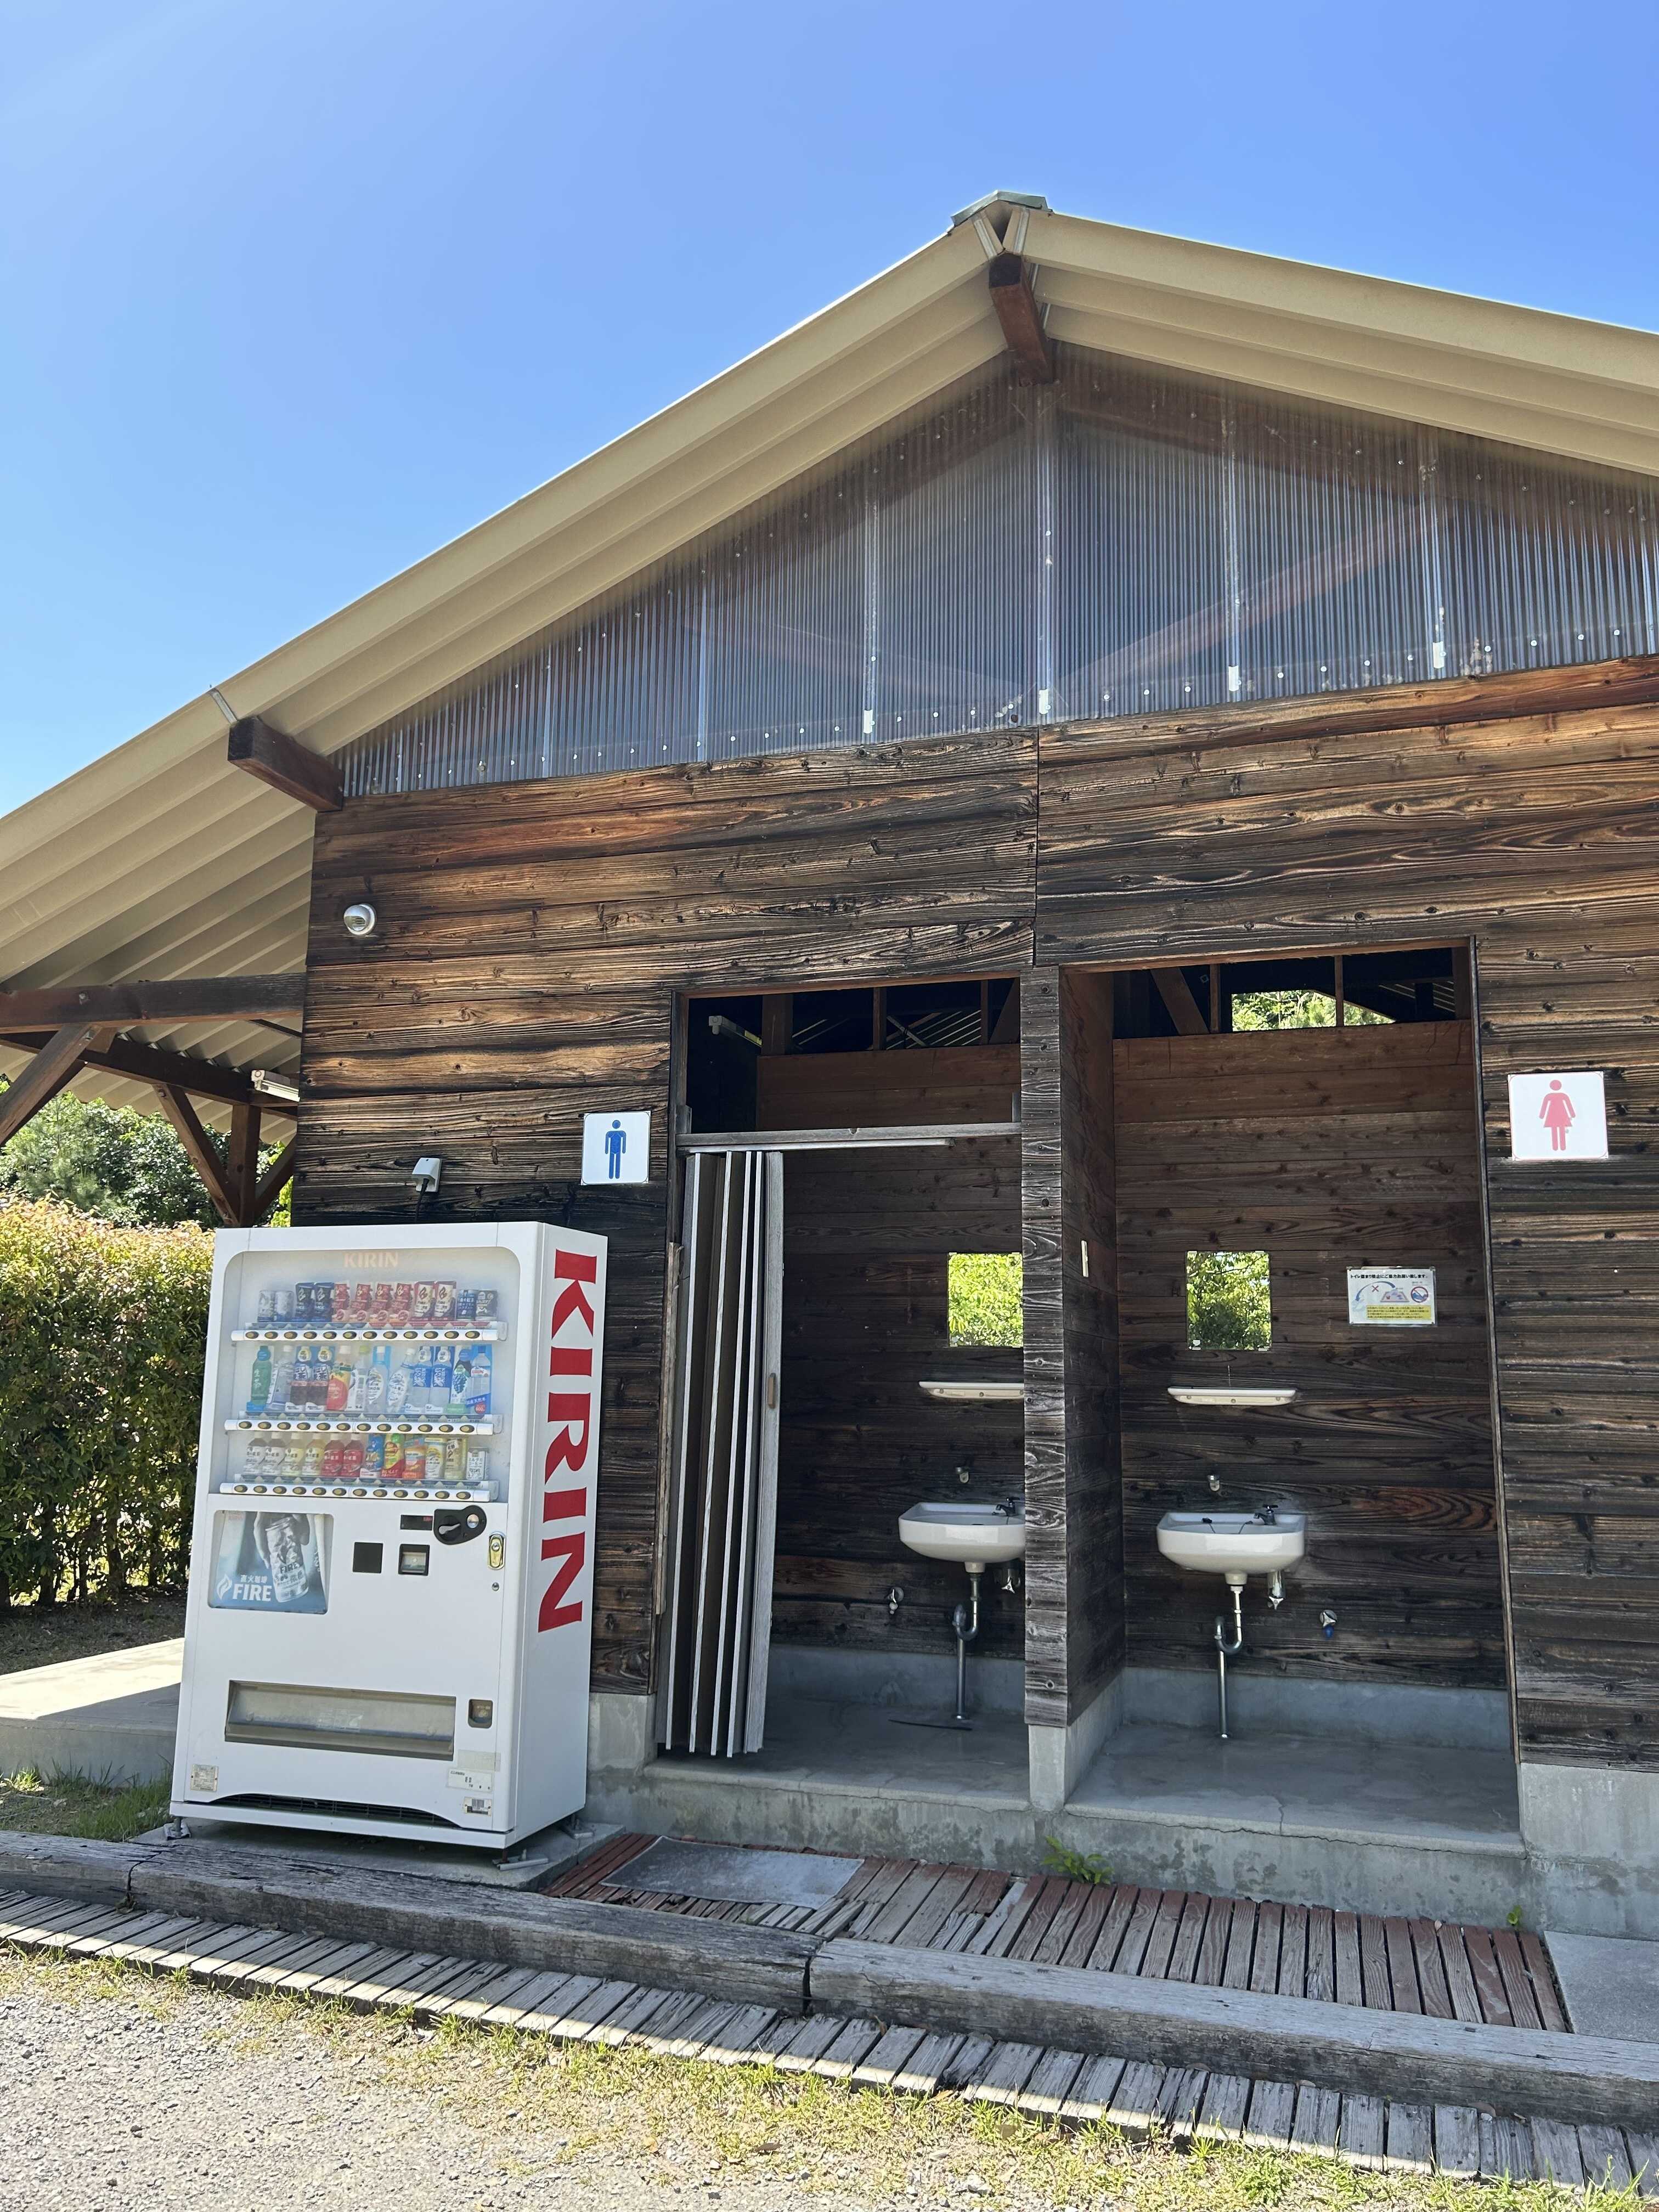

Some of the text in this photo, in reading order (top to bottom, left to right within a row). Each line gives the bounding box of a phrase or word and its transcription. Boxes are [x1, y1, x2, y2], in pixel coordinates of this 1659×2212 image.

[344, 1252, 398, 1268] KIRIN
[538, 1249, 597, 1633] KIRIN
[233, 1584, 272, 1602] FIRE
